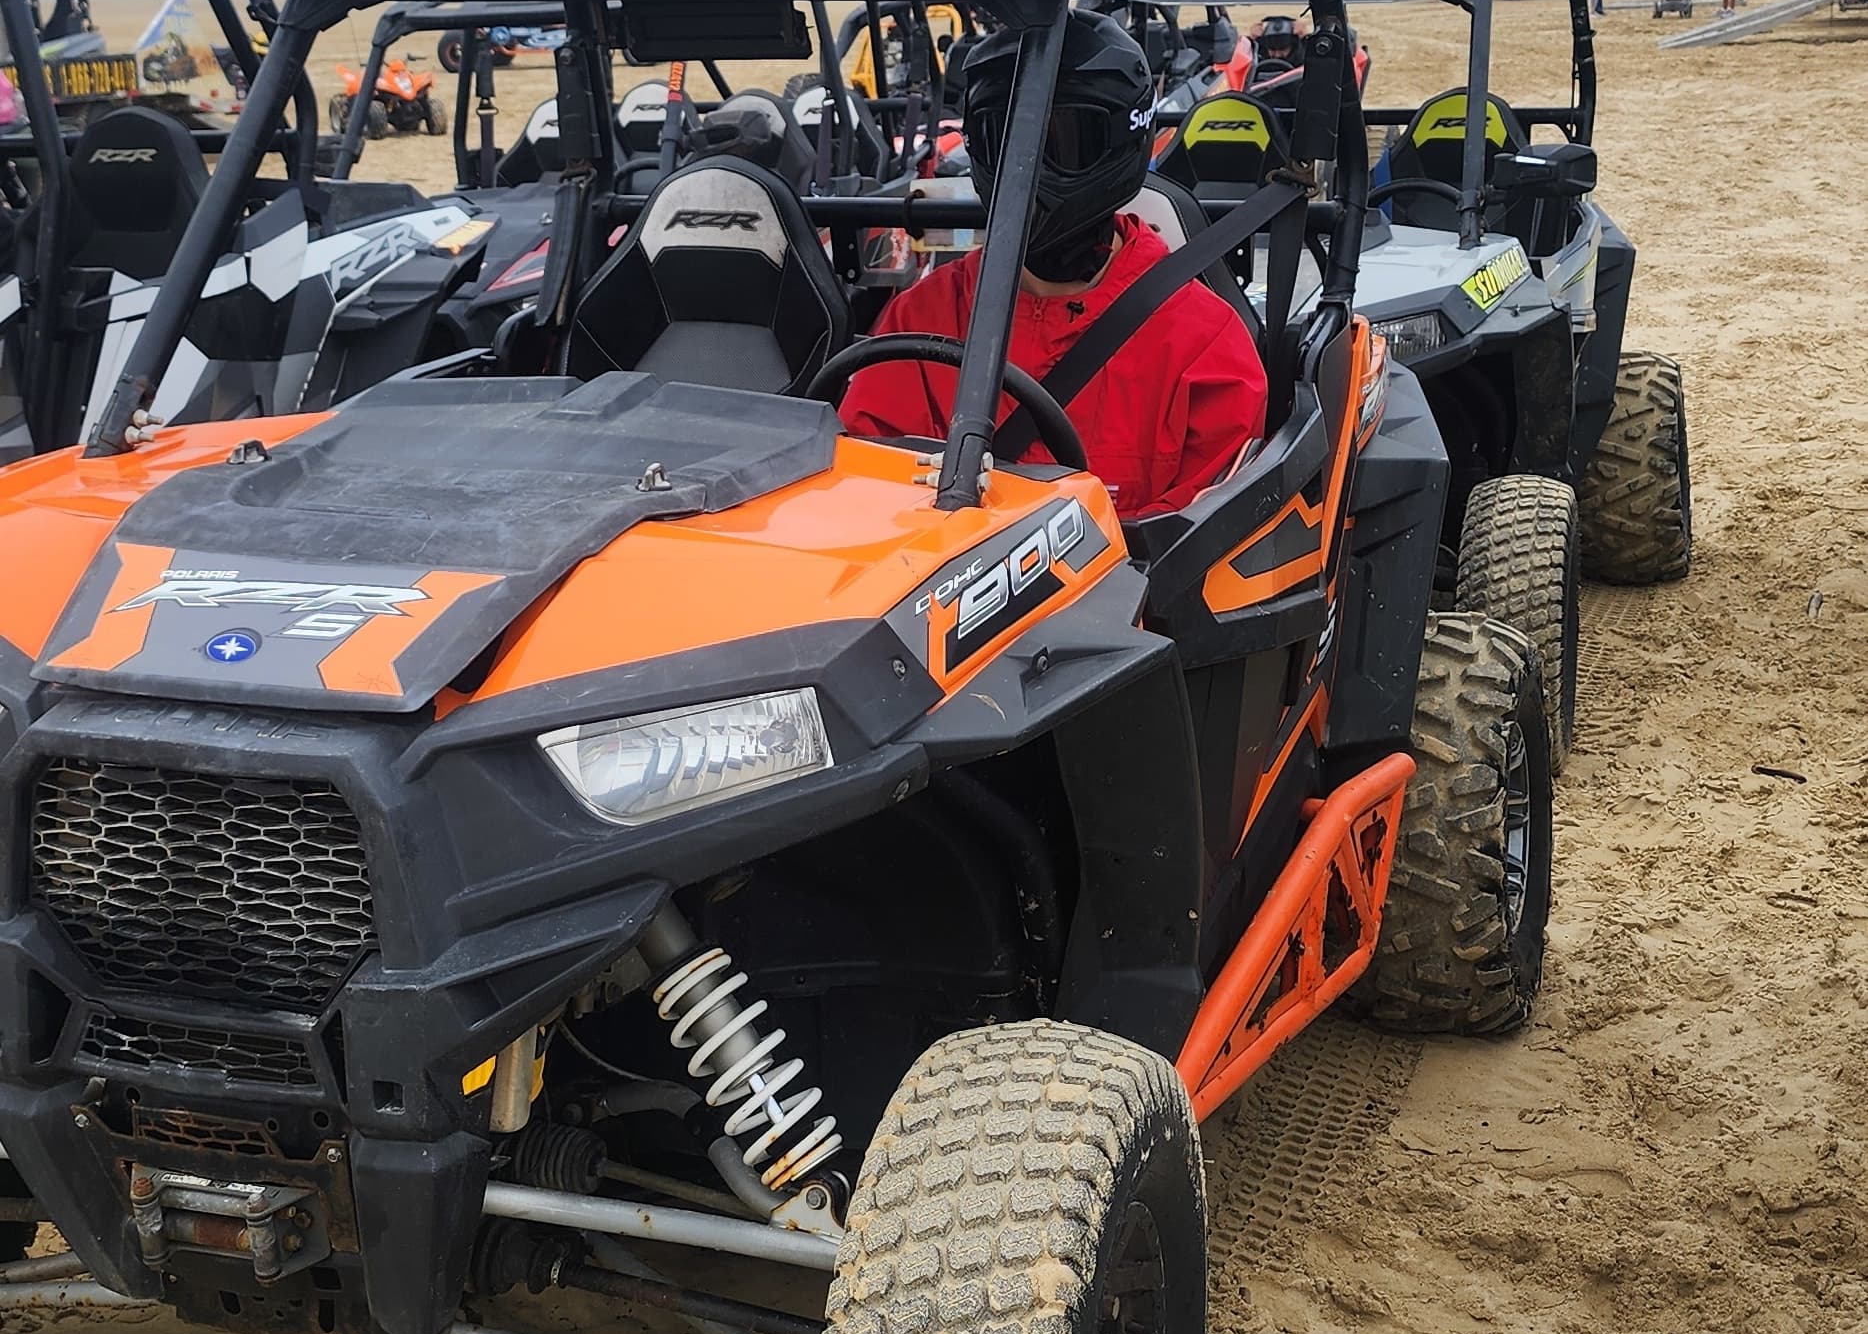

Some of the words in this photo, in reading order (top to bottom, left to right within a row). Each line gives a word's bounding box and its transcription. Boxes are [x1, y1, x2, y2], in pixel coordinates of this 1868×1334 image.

[1198, 120, 1256, 132] RZR
[89, 148, 157, 163] RZR
[663, 209, 763, 231] RZR
[331, 222, 421, 296] RZR
[160, 570, 240, 580] POLARIS
[957, 498, 1084, 641] 900
[107, 579, 431, 616] RZR
[915, 557, 985, 618] DOHC
[276, 612, 369, 638] S
